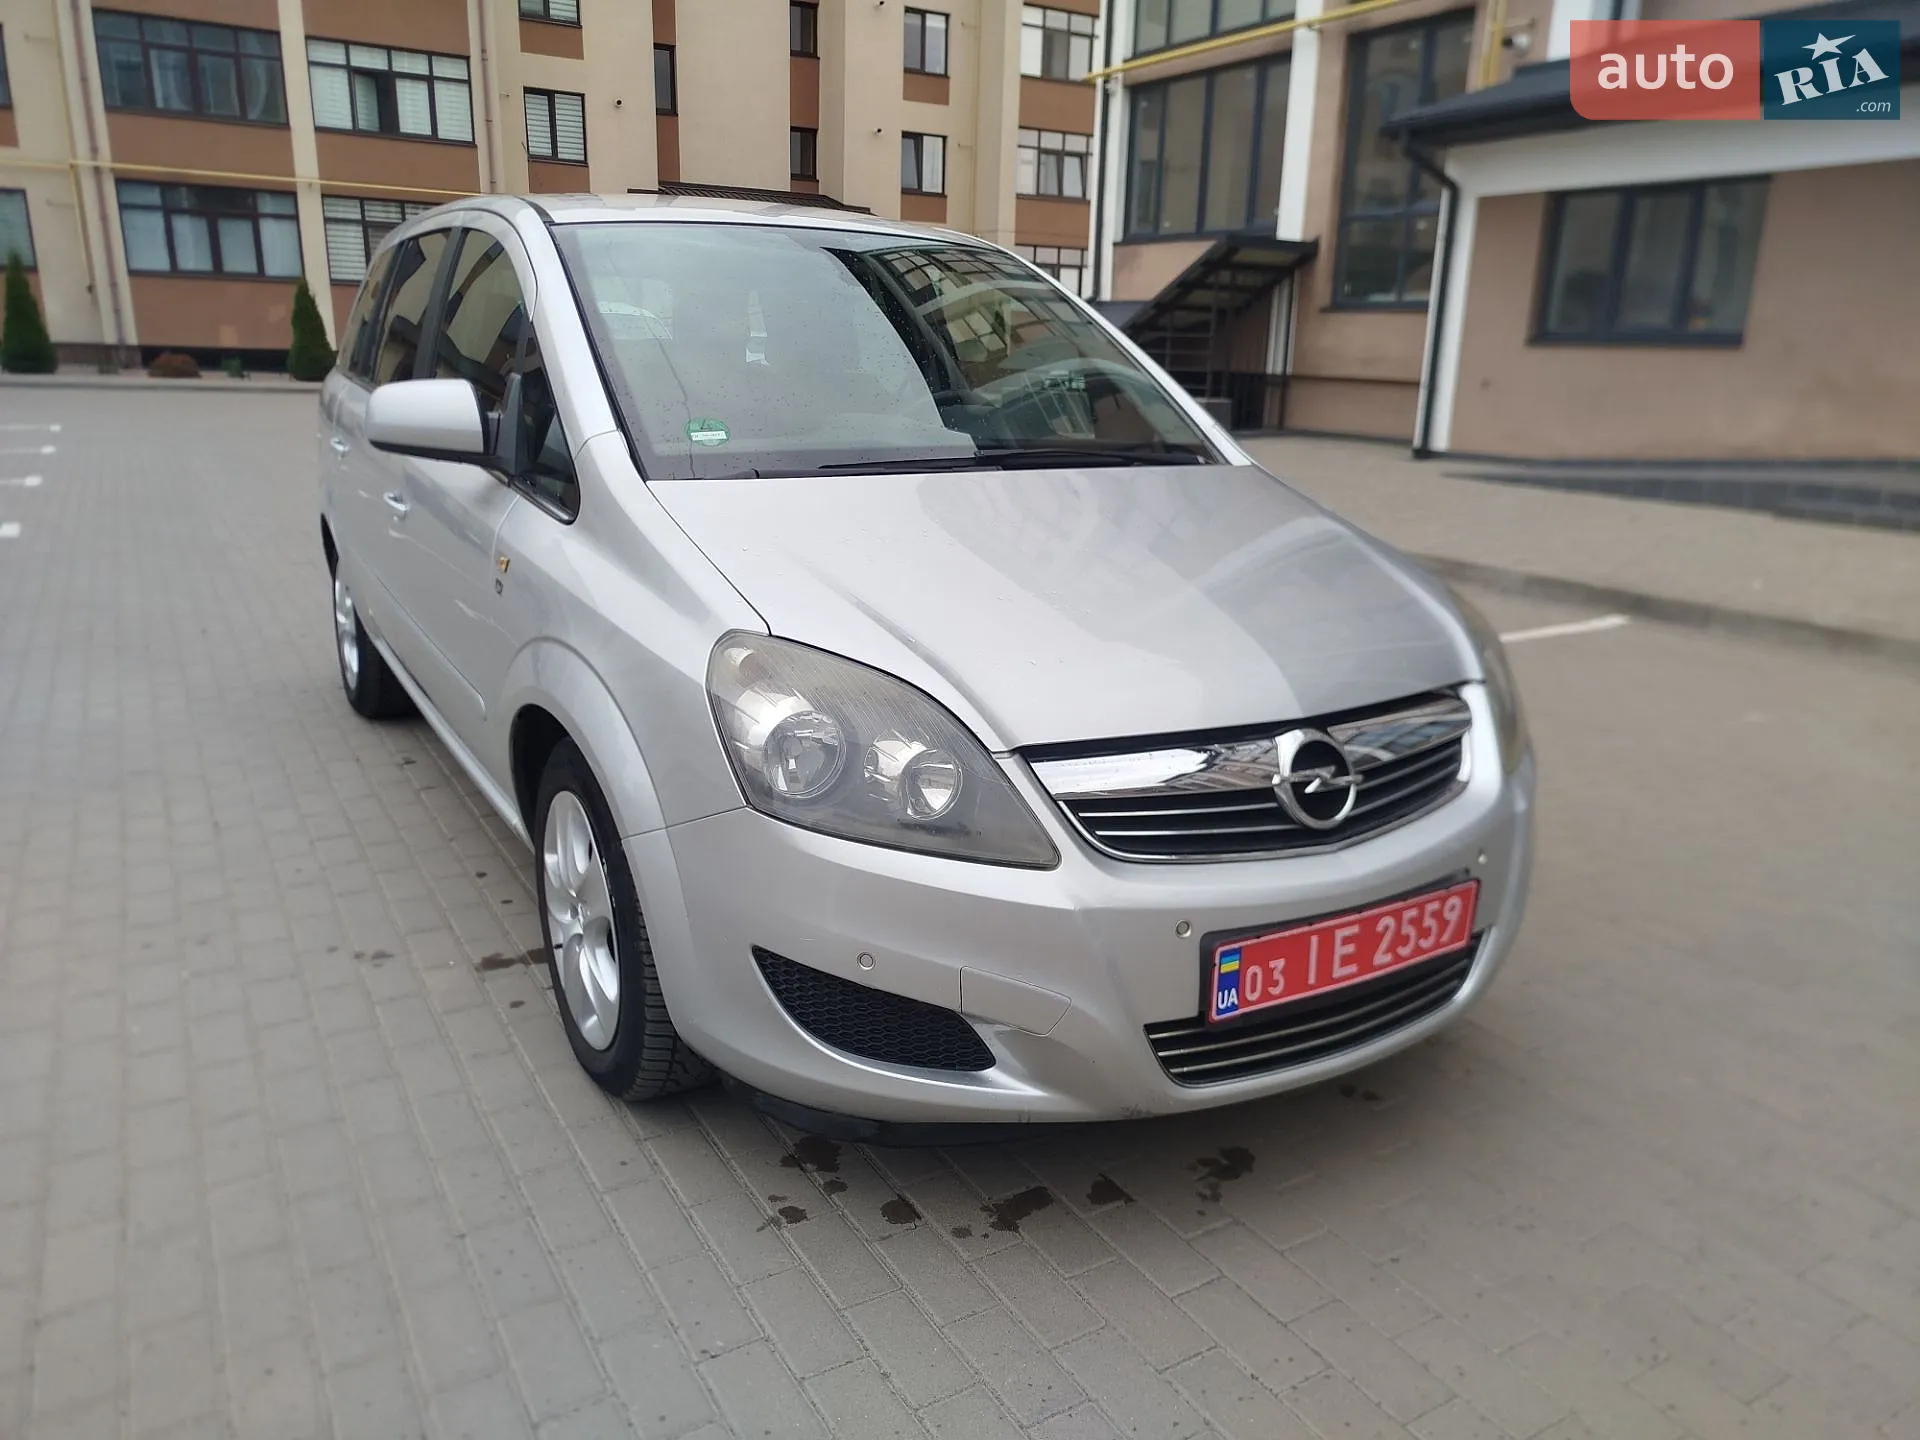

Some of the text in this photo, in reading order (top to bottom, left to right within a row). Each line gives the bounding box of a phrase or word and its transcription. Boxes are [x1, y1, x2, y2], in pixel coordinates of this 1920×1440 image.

[1244, 896, 1462, 1002] 03 IE 2559
[1217, 989, 1239, 1009] UA
